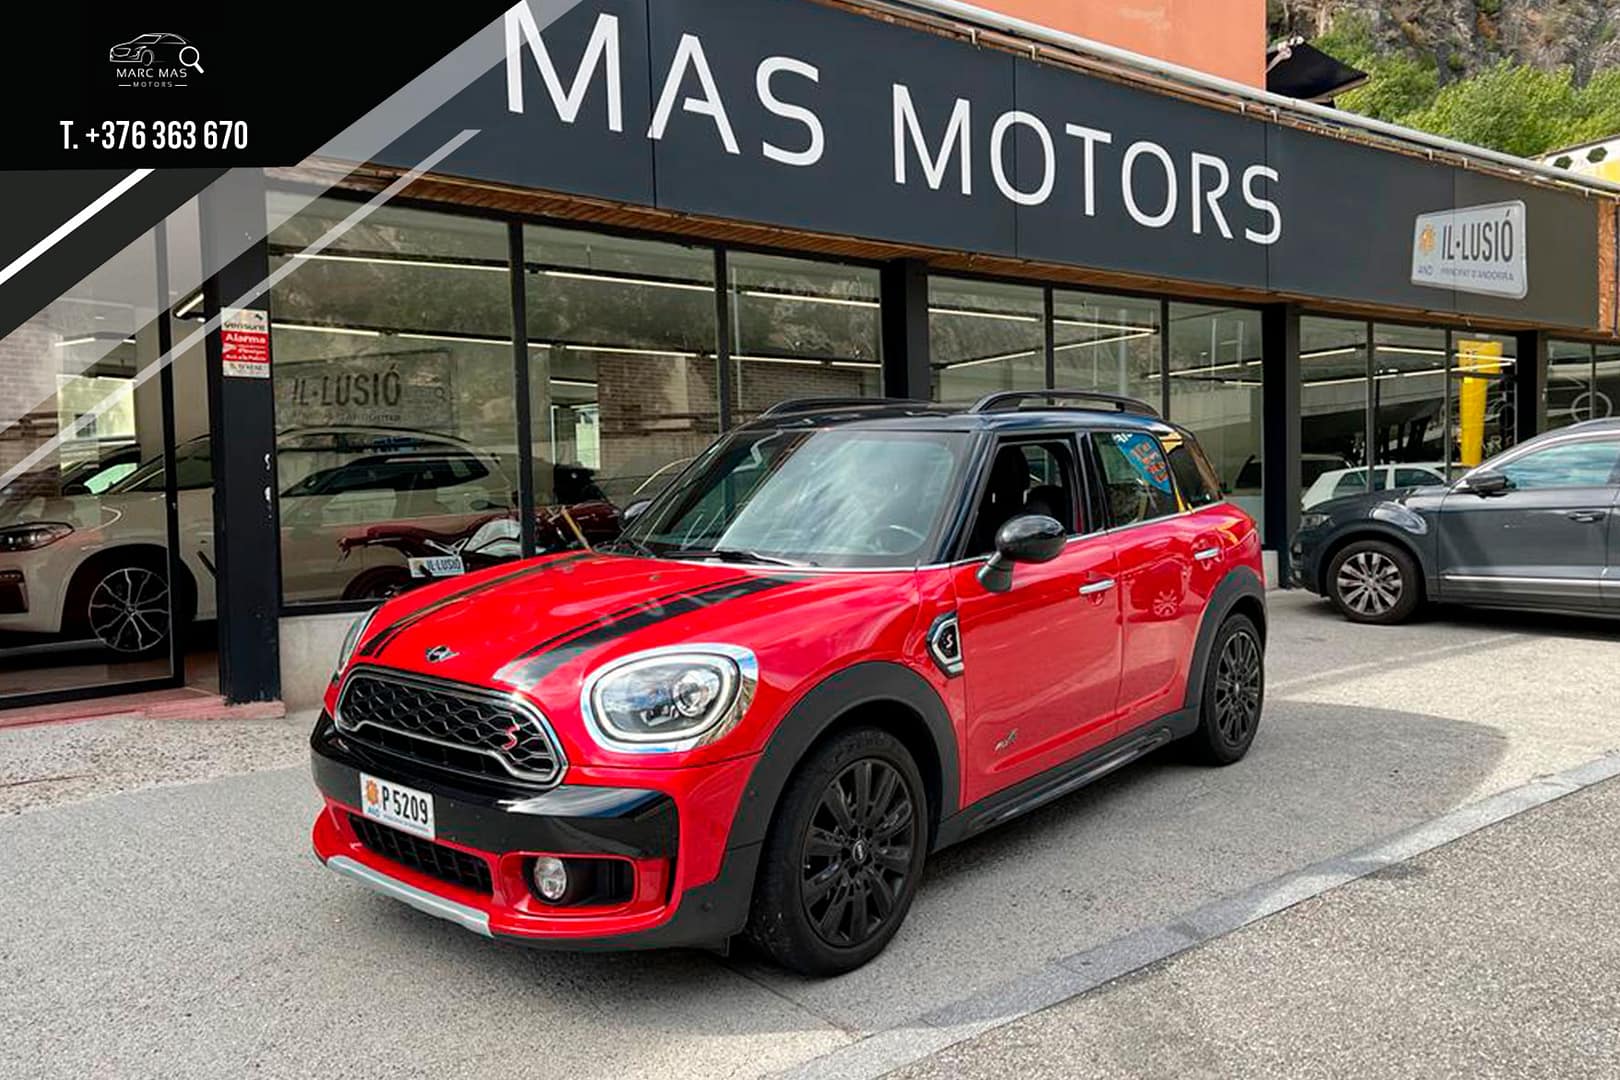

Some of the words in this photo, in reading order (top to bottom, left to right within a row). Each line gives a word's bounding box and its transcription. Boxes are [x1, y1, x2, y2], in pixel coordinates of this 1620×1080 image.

[504, 0, 825, 166] MAS
[892, 83, 1282, 245] MOTORS
[225, 333, 266, 344] Alarma
[382, 785, 390, 811] P
[393, 789, 429, 825] 5209
